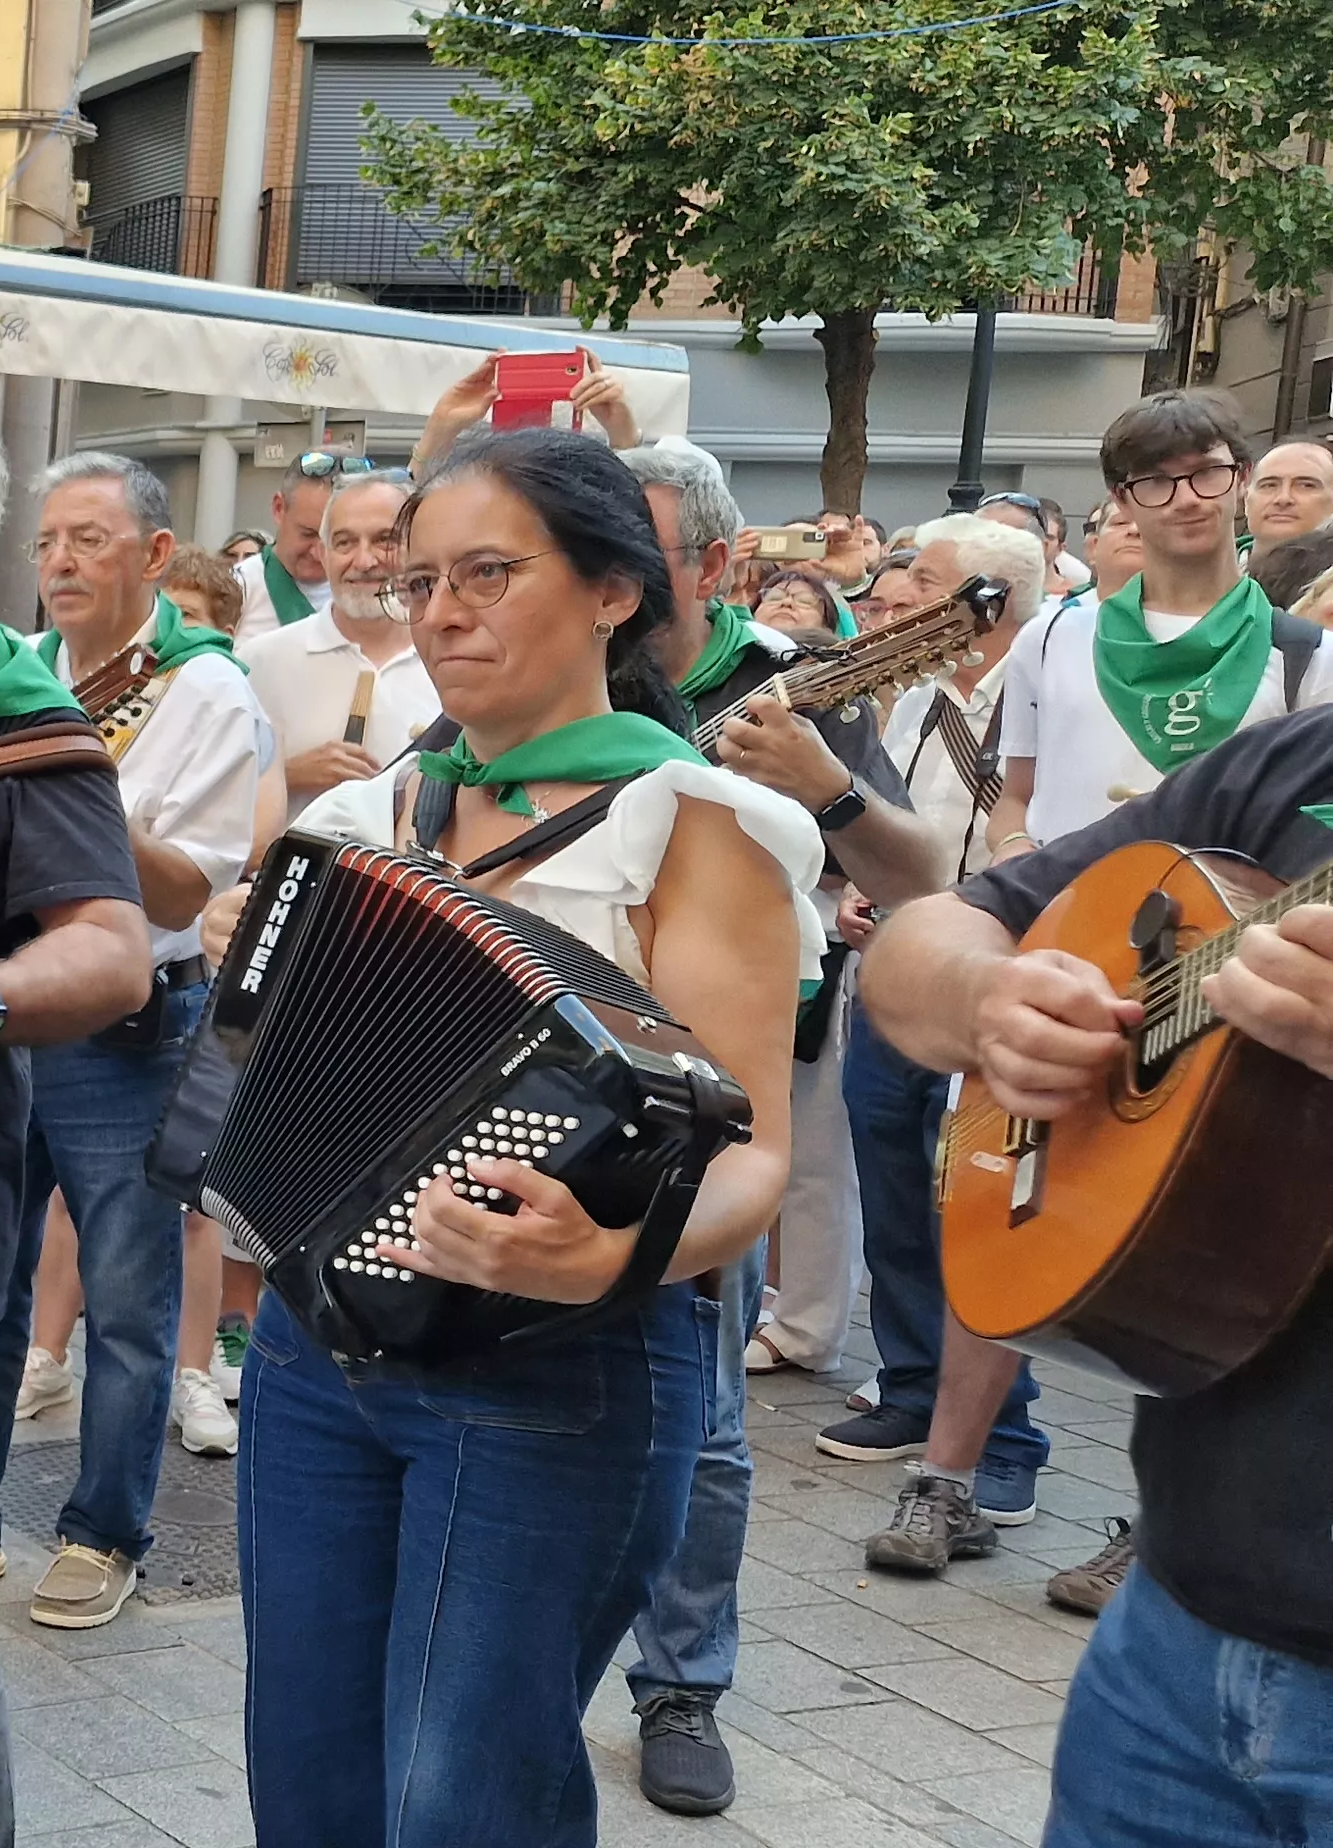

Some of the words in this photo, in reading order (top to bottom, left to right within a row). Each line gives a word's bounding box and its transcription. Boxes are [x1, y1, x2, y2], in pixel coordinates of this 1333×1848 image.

[240, 855, 310, 994] HOHNER
[500, 1045, 532, 1077] BRAVO
[537, 1027, 552, 1042] 60
